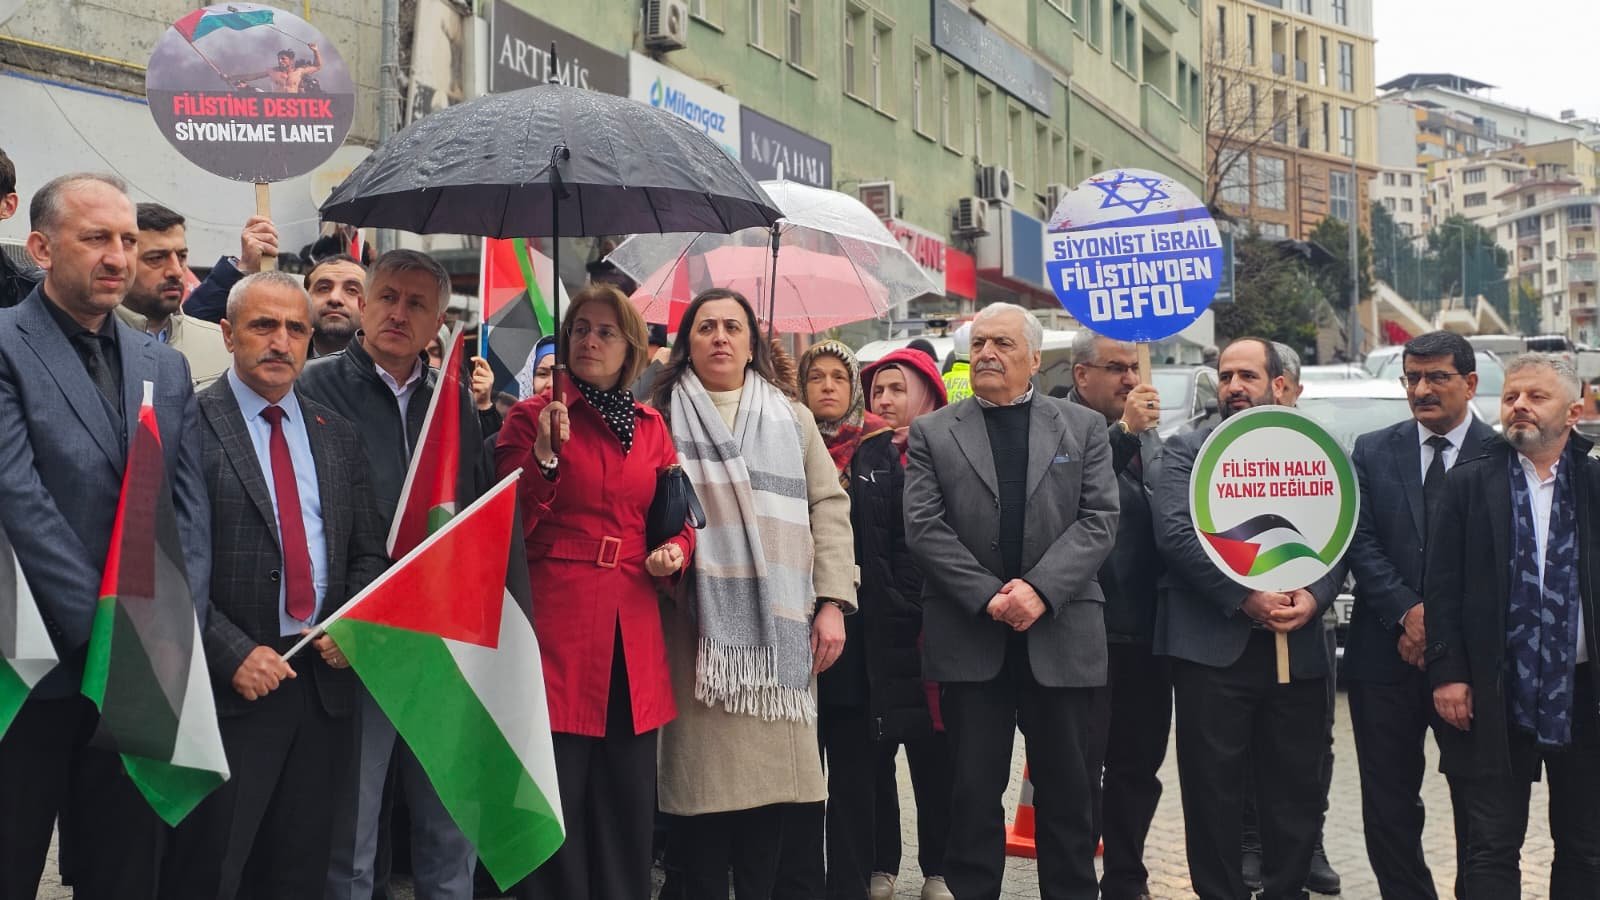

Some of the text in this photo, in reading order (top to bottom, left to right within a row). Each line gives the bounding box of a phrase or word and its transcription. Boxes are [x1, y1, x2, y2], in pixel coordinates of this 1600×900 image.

[498, 33, 589, 90] ARTEMİS
[173, 92, 333, 118] FİLİSTİNE DESTEK
[664, 86, 725, 136] Milangaz
[175, 119, 334, 143] SİYONİZME LANET
[1053, 225, 1217, 259] SİYONİST İSRAİL
[1061, 256, 1213, 291] FİLİSTİN'DEN
[1088, 283, 1195, 322] DEFOL
[1222, 458, 1326, 477] FİLİSTİN HALKI
[1216, 477, 1334, 498] YALNIZ DEĞİLDİR
